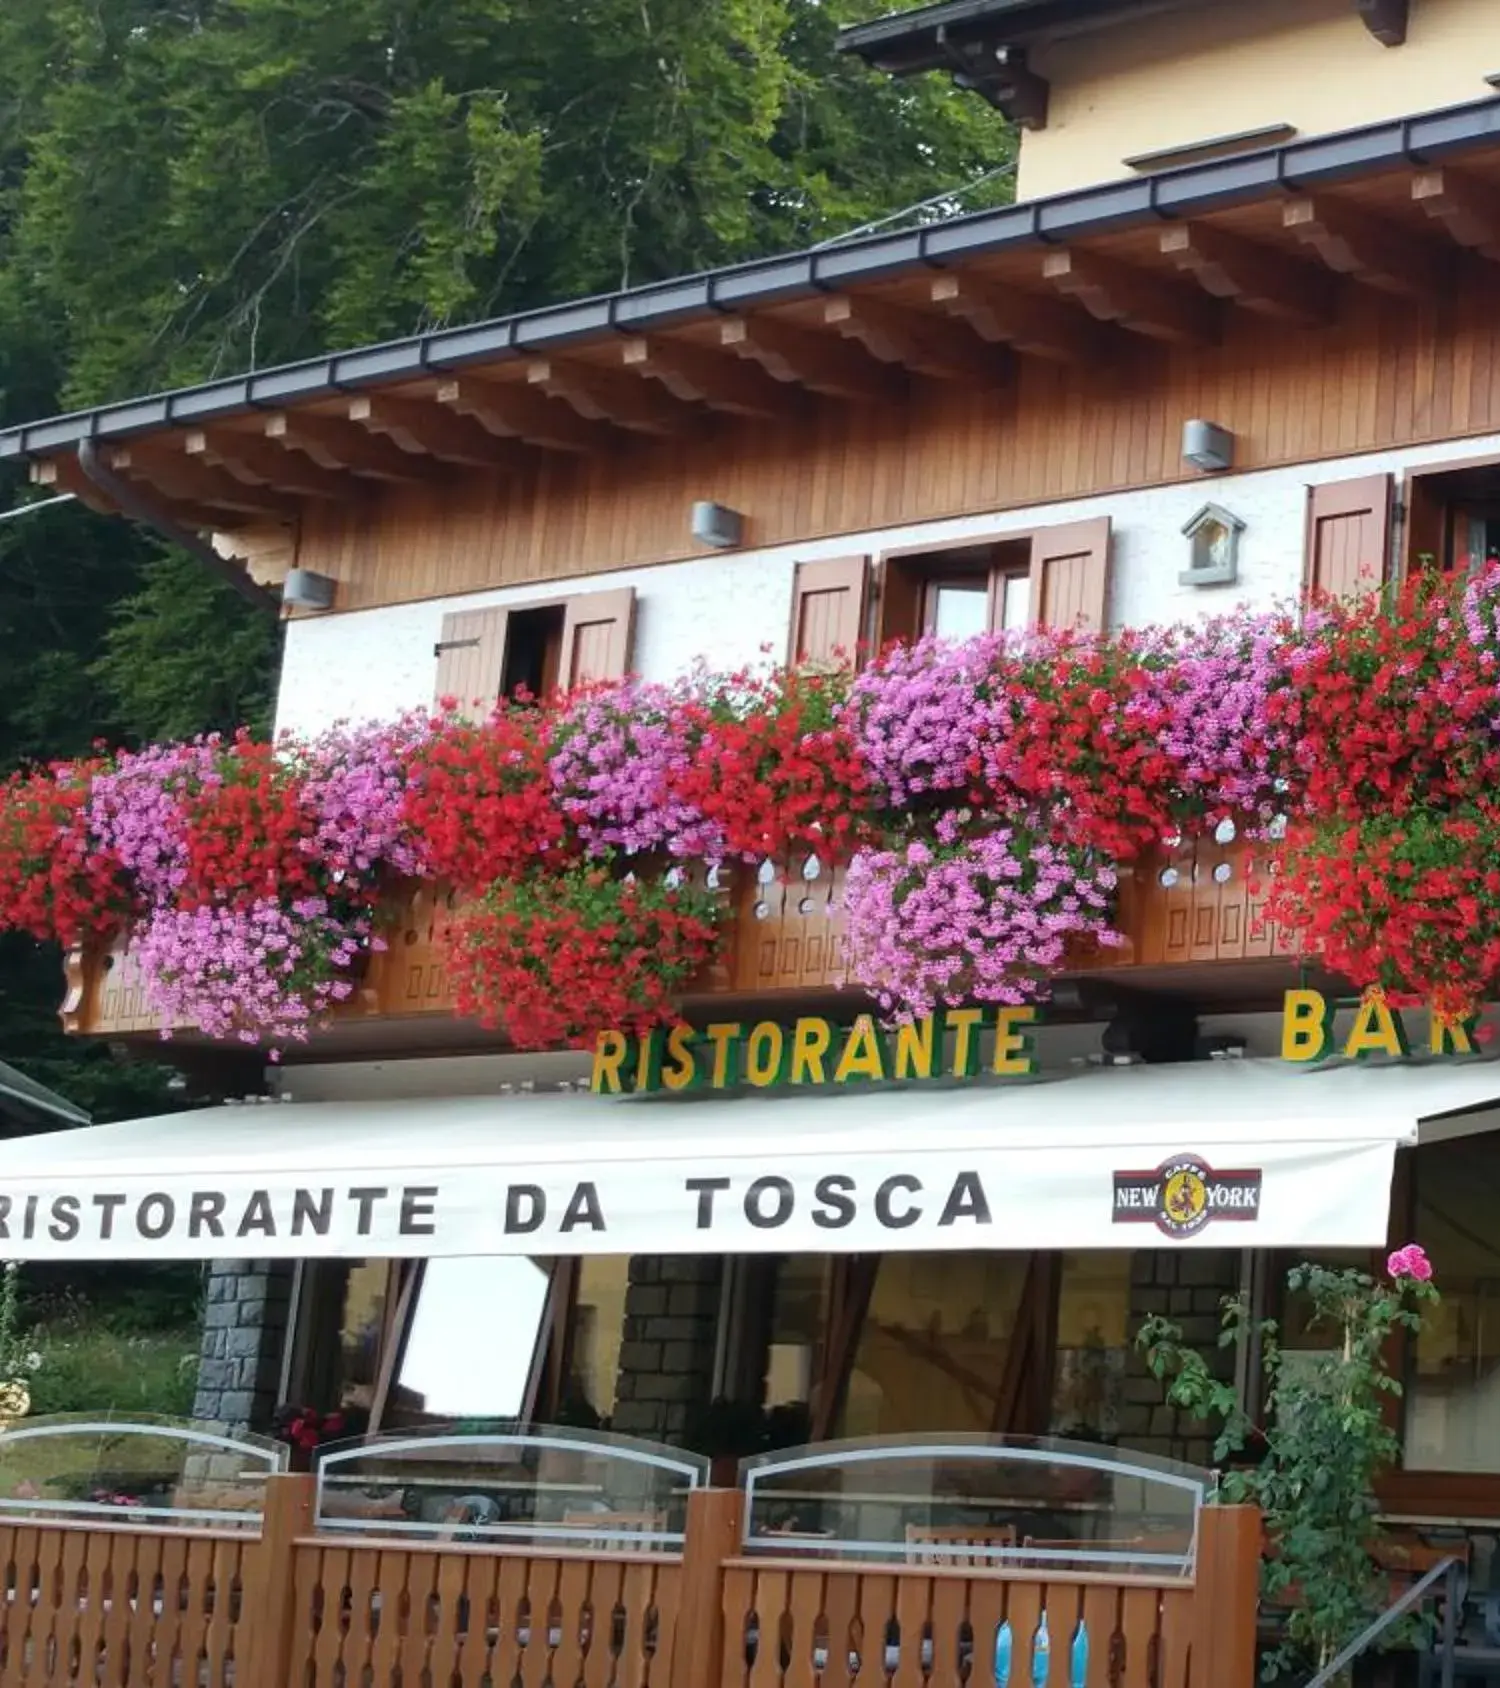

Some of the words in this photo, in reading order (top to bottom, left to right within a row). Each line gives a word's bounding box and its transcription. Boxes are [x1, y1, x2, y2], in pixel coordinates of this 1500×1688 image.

[590, 1006, 1036, 1093] RISTORANTE
[503, 1181, 607, 1234] DA
[685, 1170, 993, 1229] TOSCA
[1116, 1183, 1160, 1207] NEW
[1205, 1183, 1257, 1207] YORK
